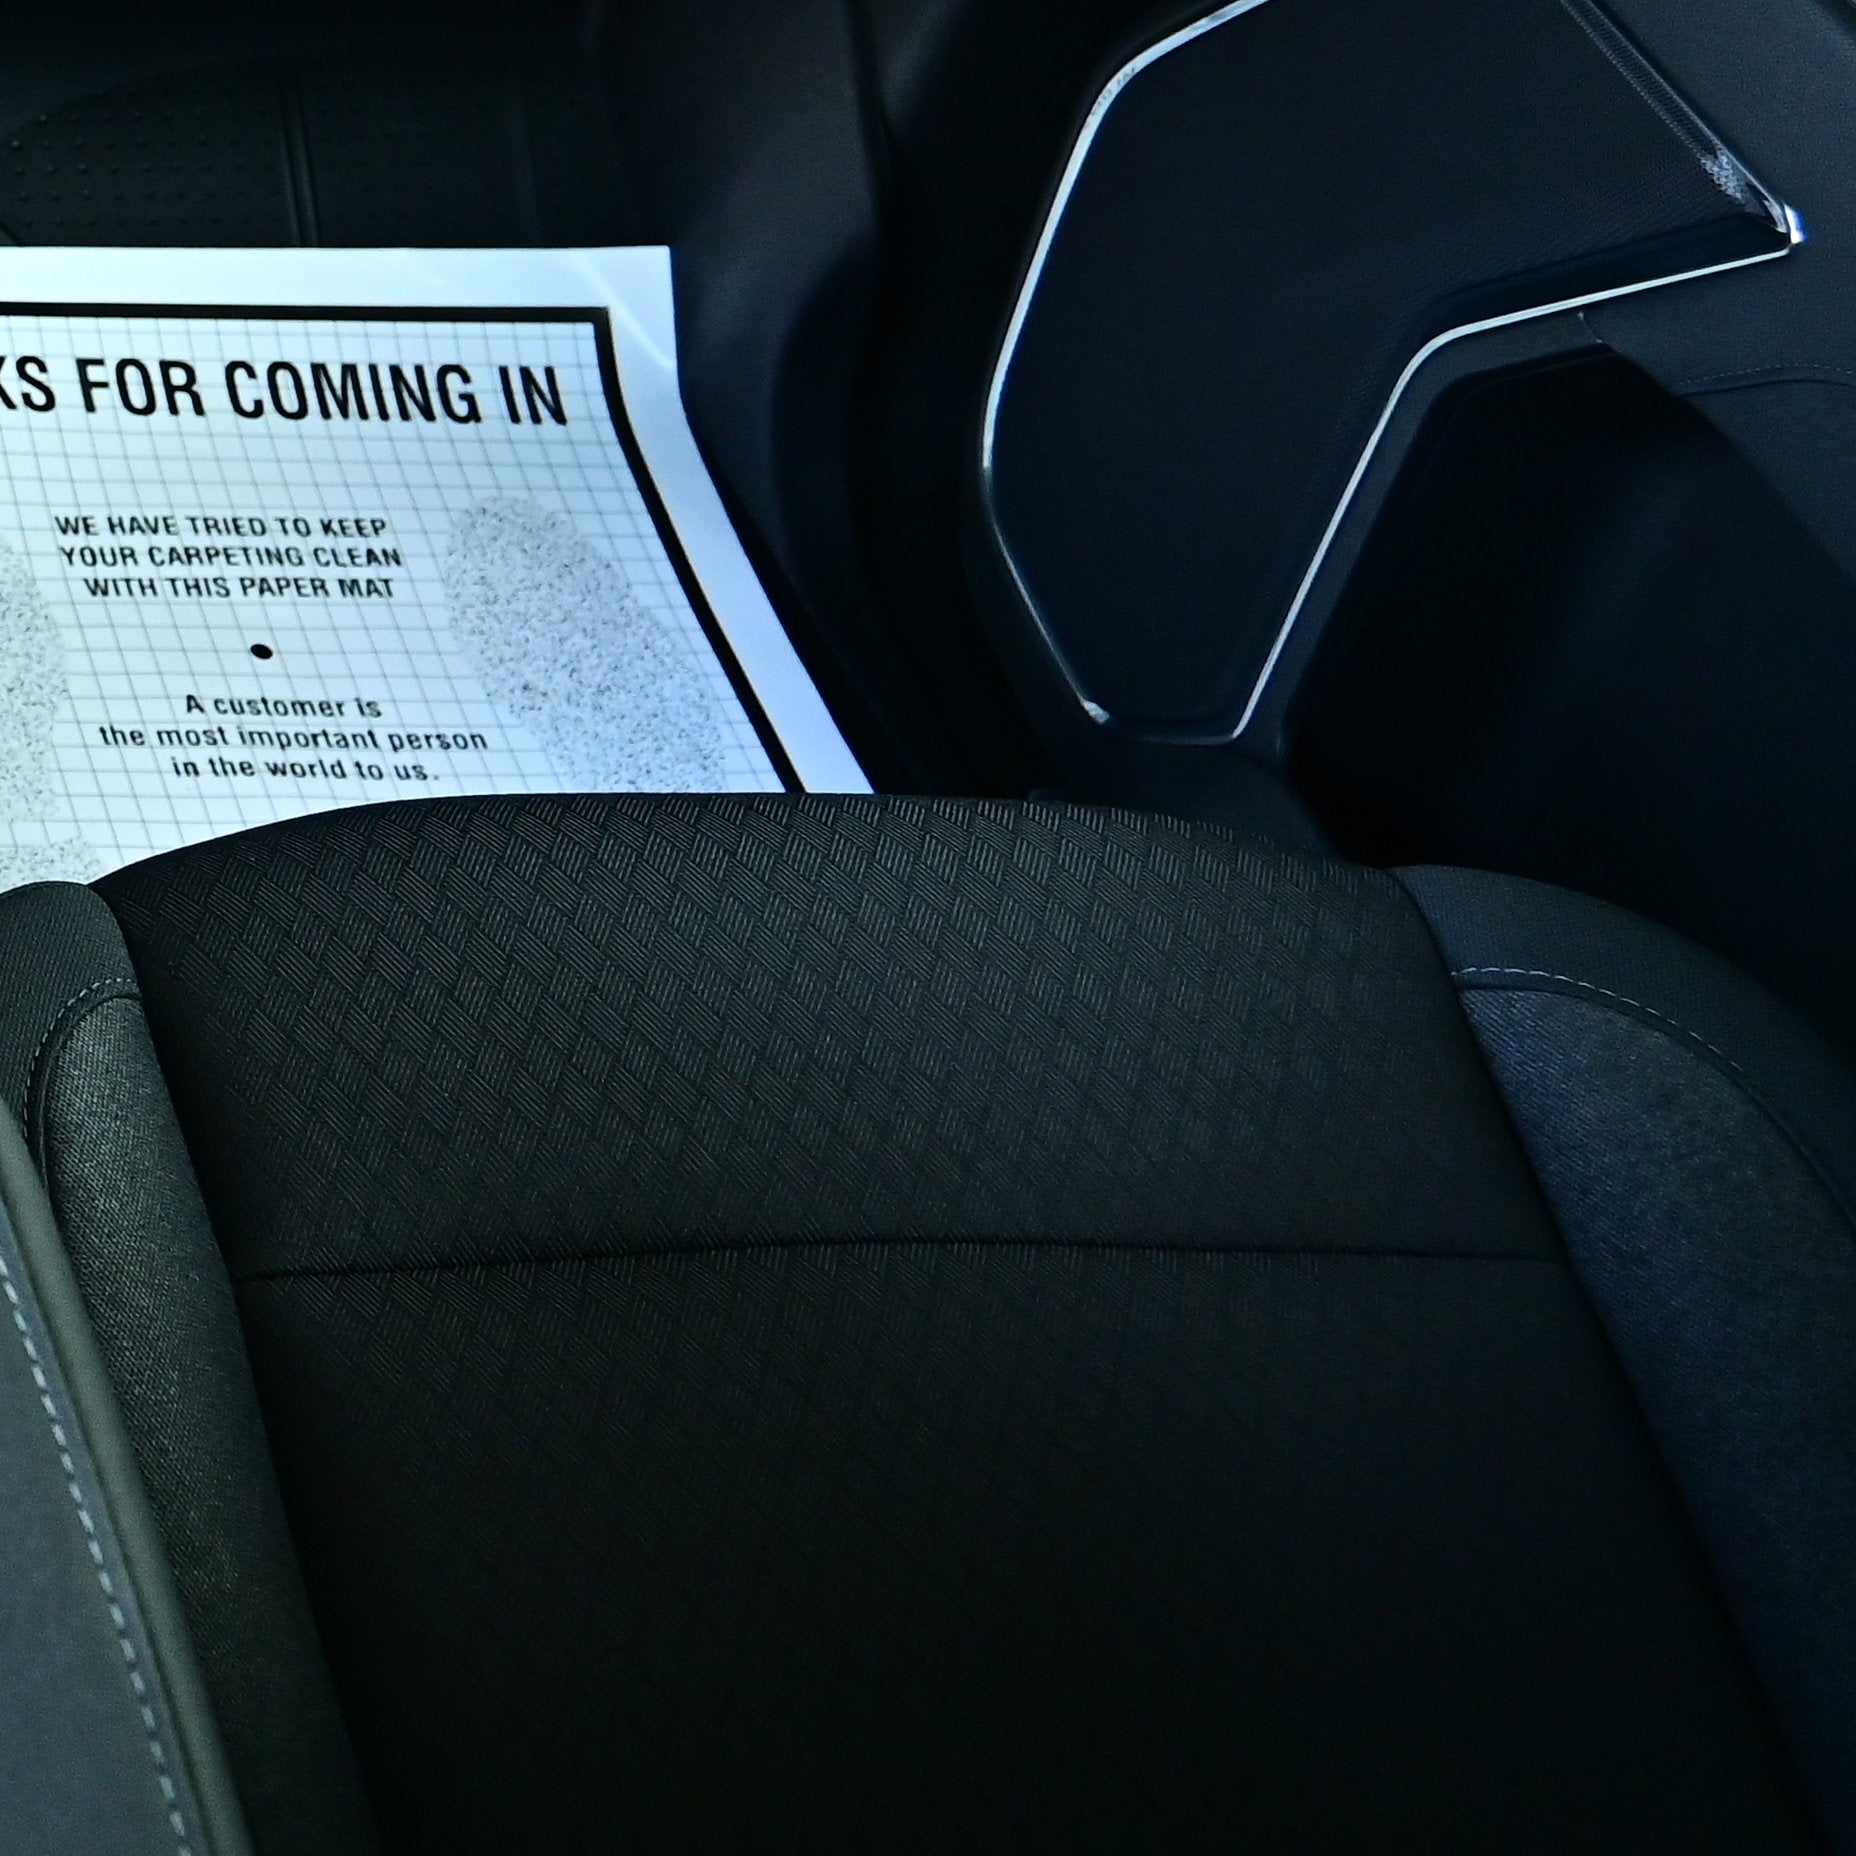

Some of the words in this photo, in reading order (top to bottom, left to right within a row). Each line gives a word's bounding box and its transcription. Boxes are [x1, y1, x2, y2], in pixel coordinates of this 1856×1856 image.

[78, 358, 206, 417] FOR
[225, 361, 482, 426] COMING
[502, 365, 569, 427] IN
[55, 515, 98, 537] WE
[108, 515, 178, 537] HAVE
[188, 516, 267, 538] TRIED
[275, 517, 312, 539] TO
[320, 517, 387, 539] KEEP
[60, 546, 138, 568] YOUR
[148, 546, 304, 568] CARPETING
[313, 547, 402, 568] CLEAN
[84, 577, 156, 599] WITH
[168, 577, 231, 599] THIS
[240, 577, 329, 599] PAPER
[338, 578, 396, 600] MAT
[186, 694, 205, 715] A
[214, 696, 345, 718] customer
[355, 697, 382, 718] is
[99, 725, 146, 747] the
[156, 727, 230, 747] most
[237, 727, 379, 755] important
[388, 730, 487, 755] person
[172, 757, 200, 777] in
[208, 758, 256, 779] the
[265, 759, 345, 780] world
[354, 760, 385, 782] to
[394, 761, 440, 783] us.
